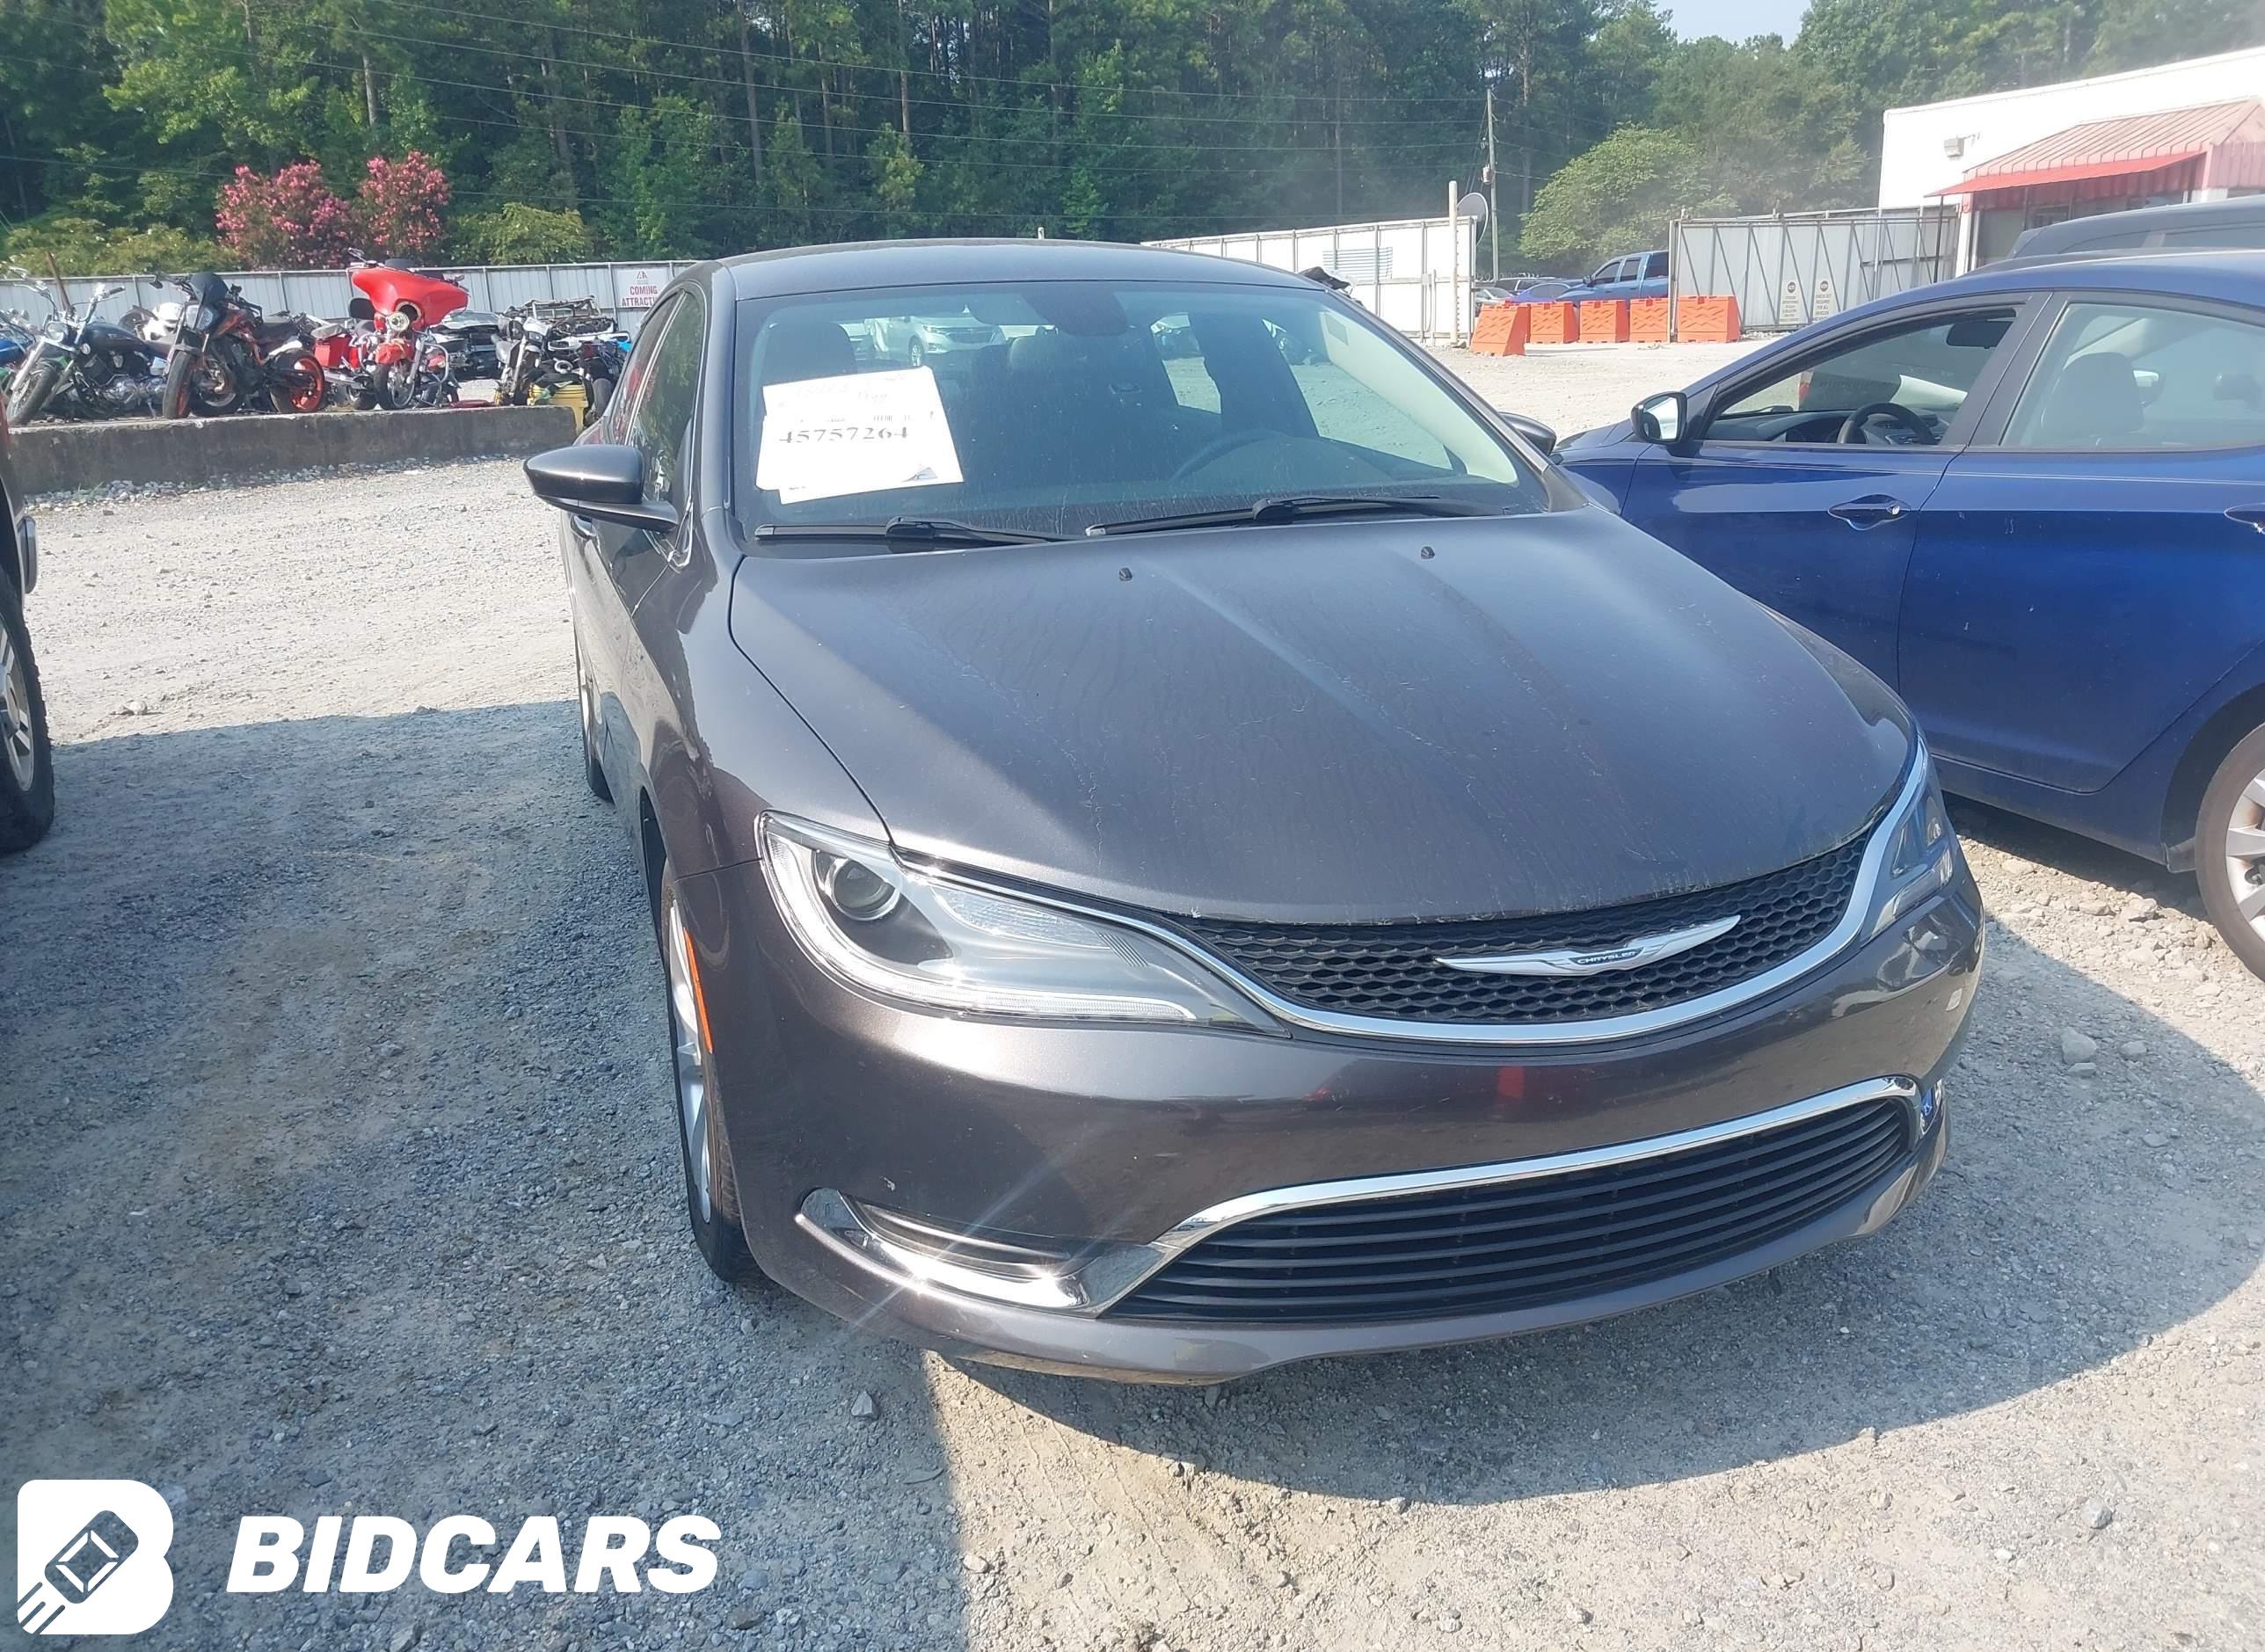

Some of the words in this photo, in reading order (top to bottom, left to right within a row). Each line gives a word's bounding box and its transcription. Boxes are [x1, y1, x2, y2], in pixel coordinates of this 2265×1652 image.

[630, 286, 658, 295] COMING
[779, 426, 909, 444] 45757264
[1577, 951, 1636, 964] CHRYSLER
